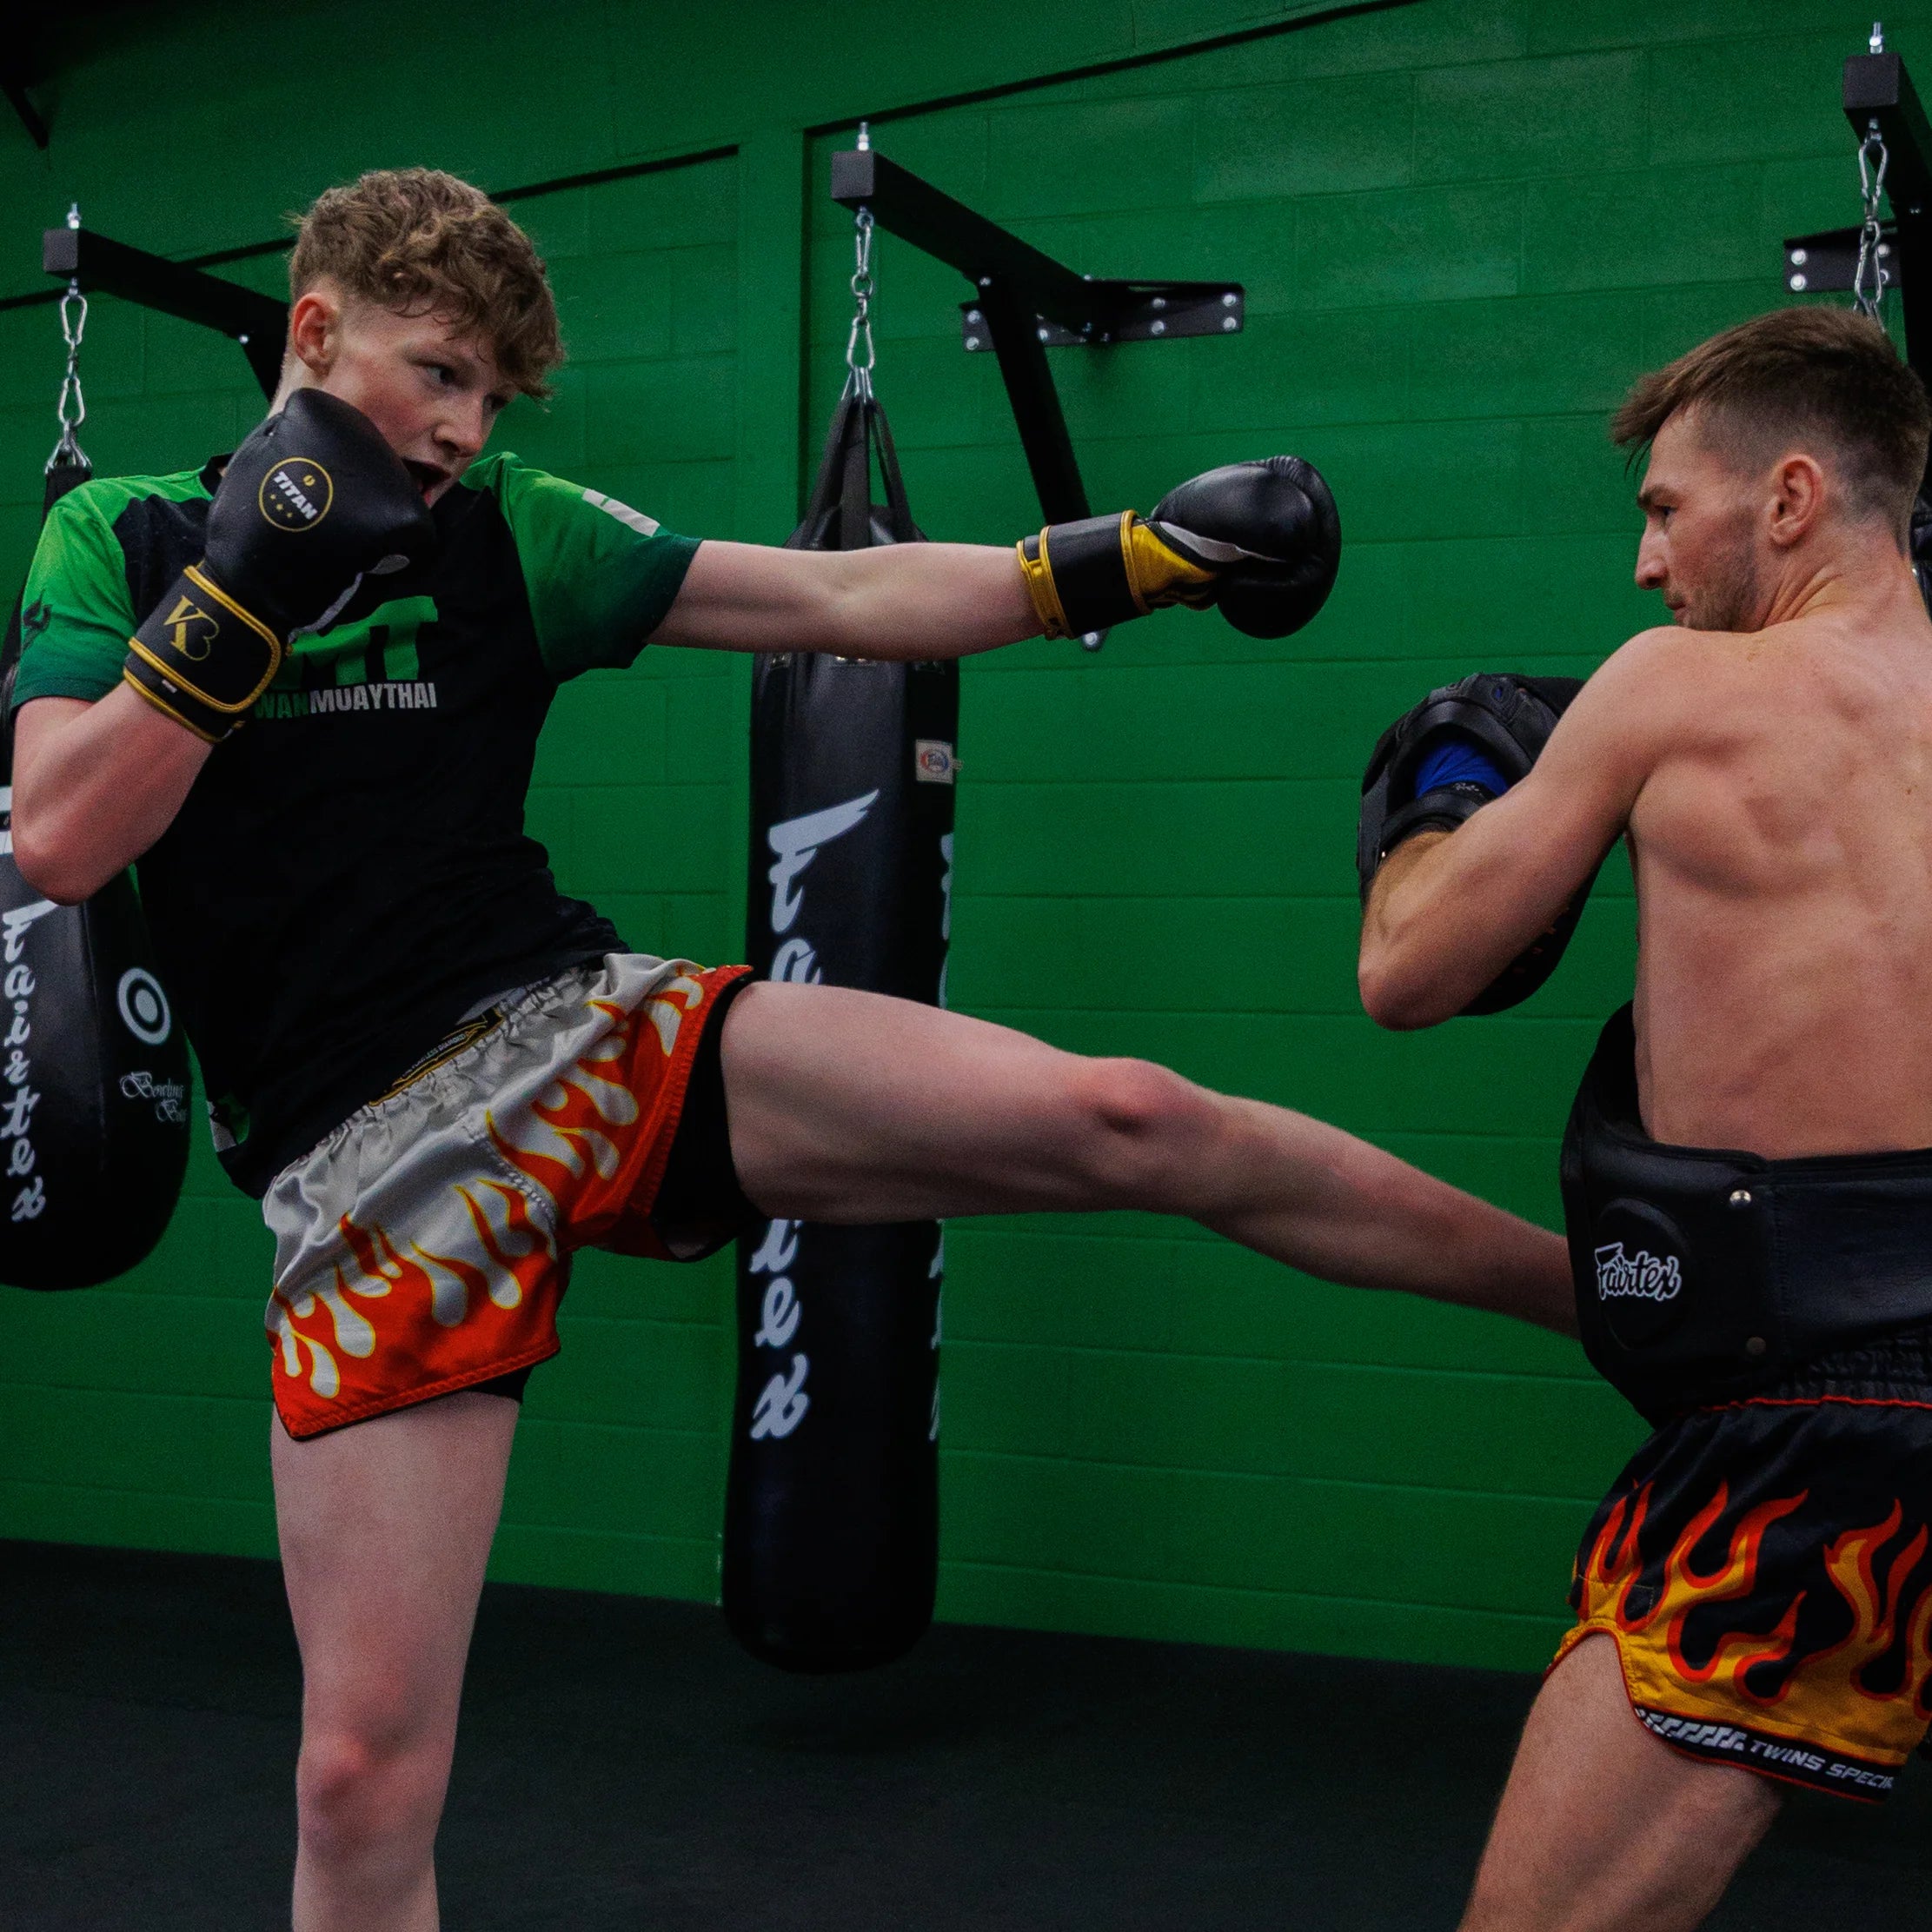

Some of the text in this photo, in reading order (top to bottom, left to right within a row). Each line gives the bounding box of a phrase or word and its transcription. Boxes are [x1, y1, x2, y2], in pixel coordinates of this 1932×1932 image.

[273, 470, 318, 520] TITAN
[1595, 1241, 1682, 1301] Fairtex
[1749, 1740, 1826, 1772] TWINS
